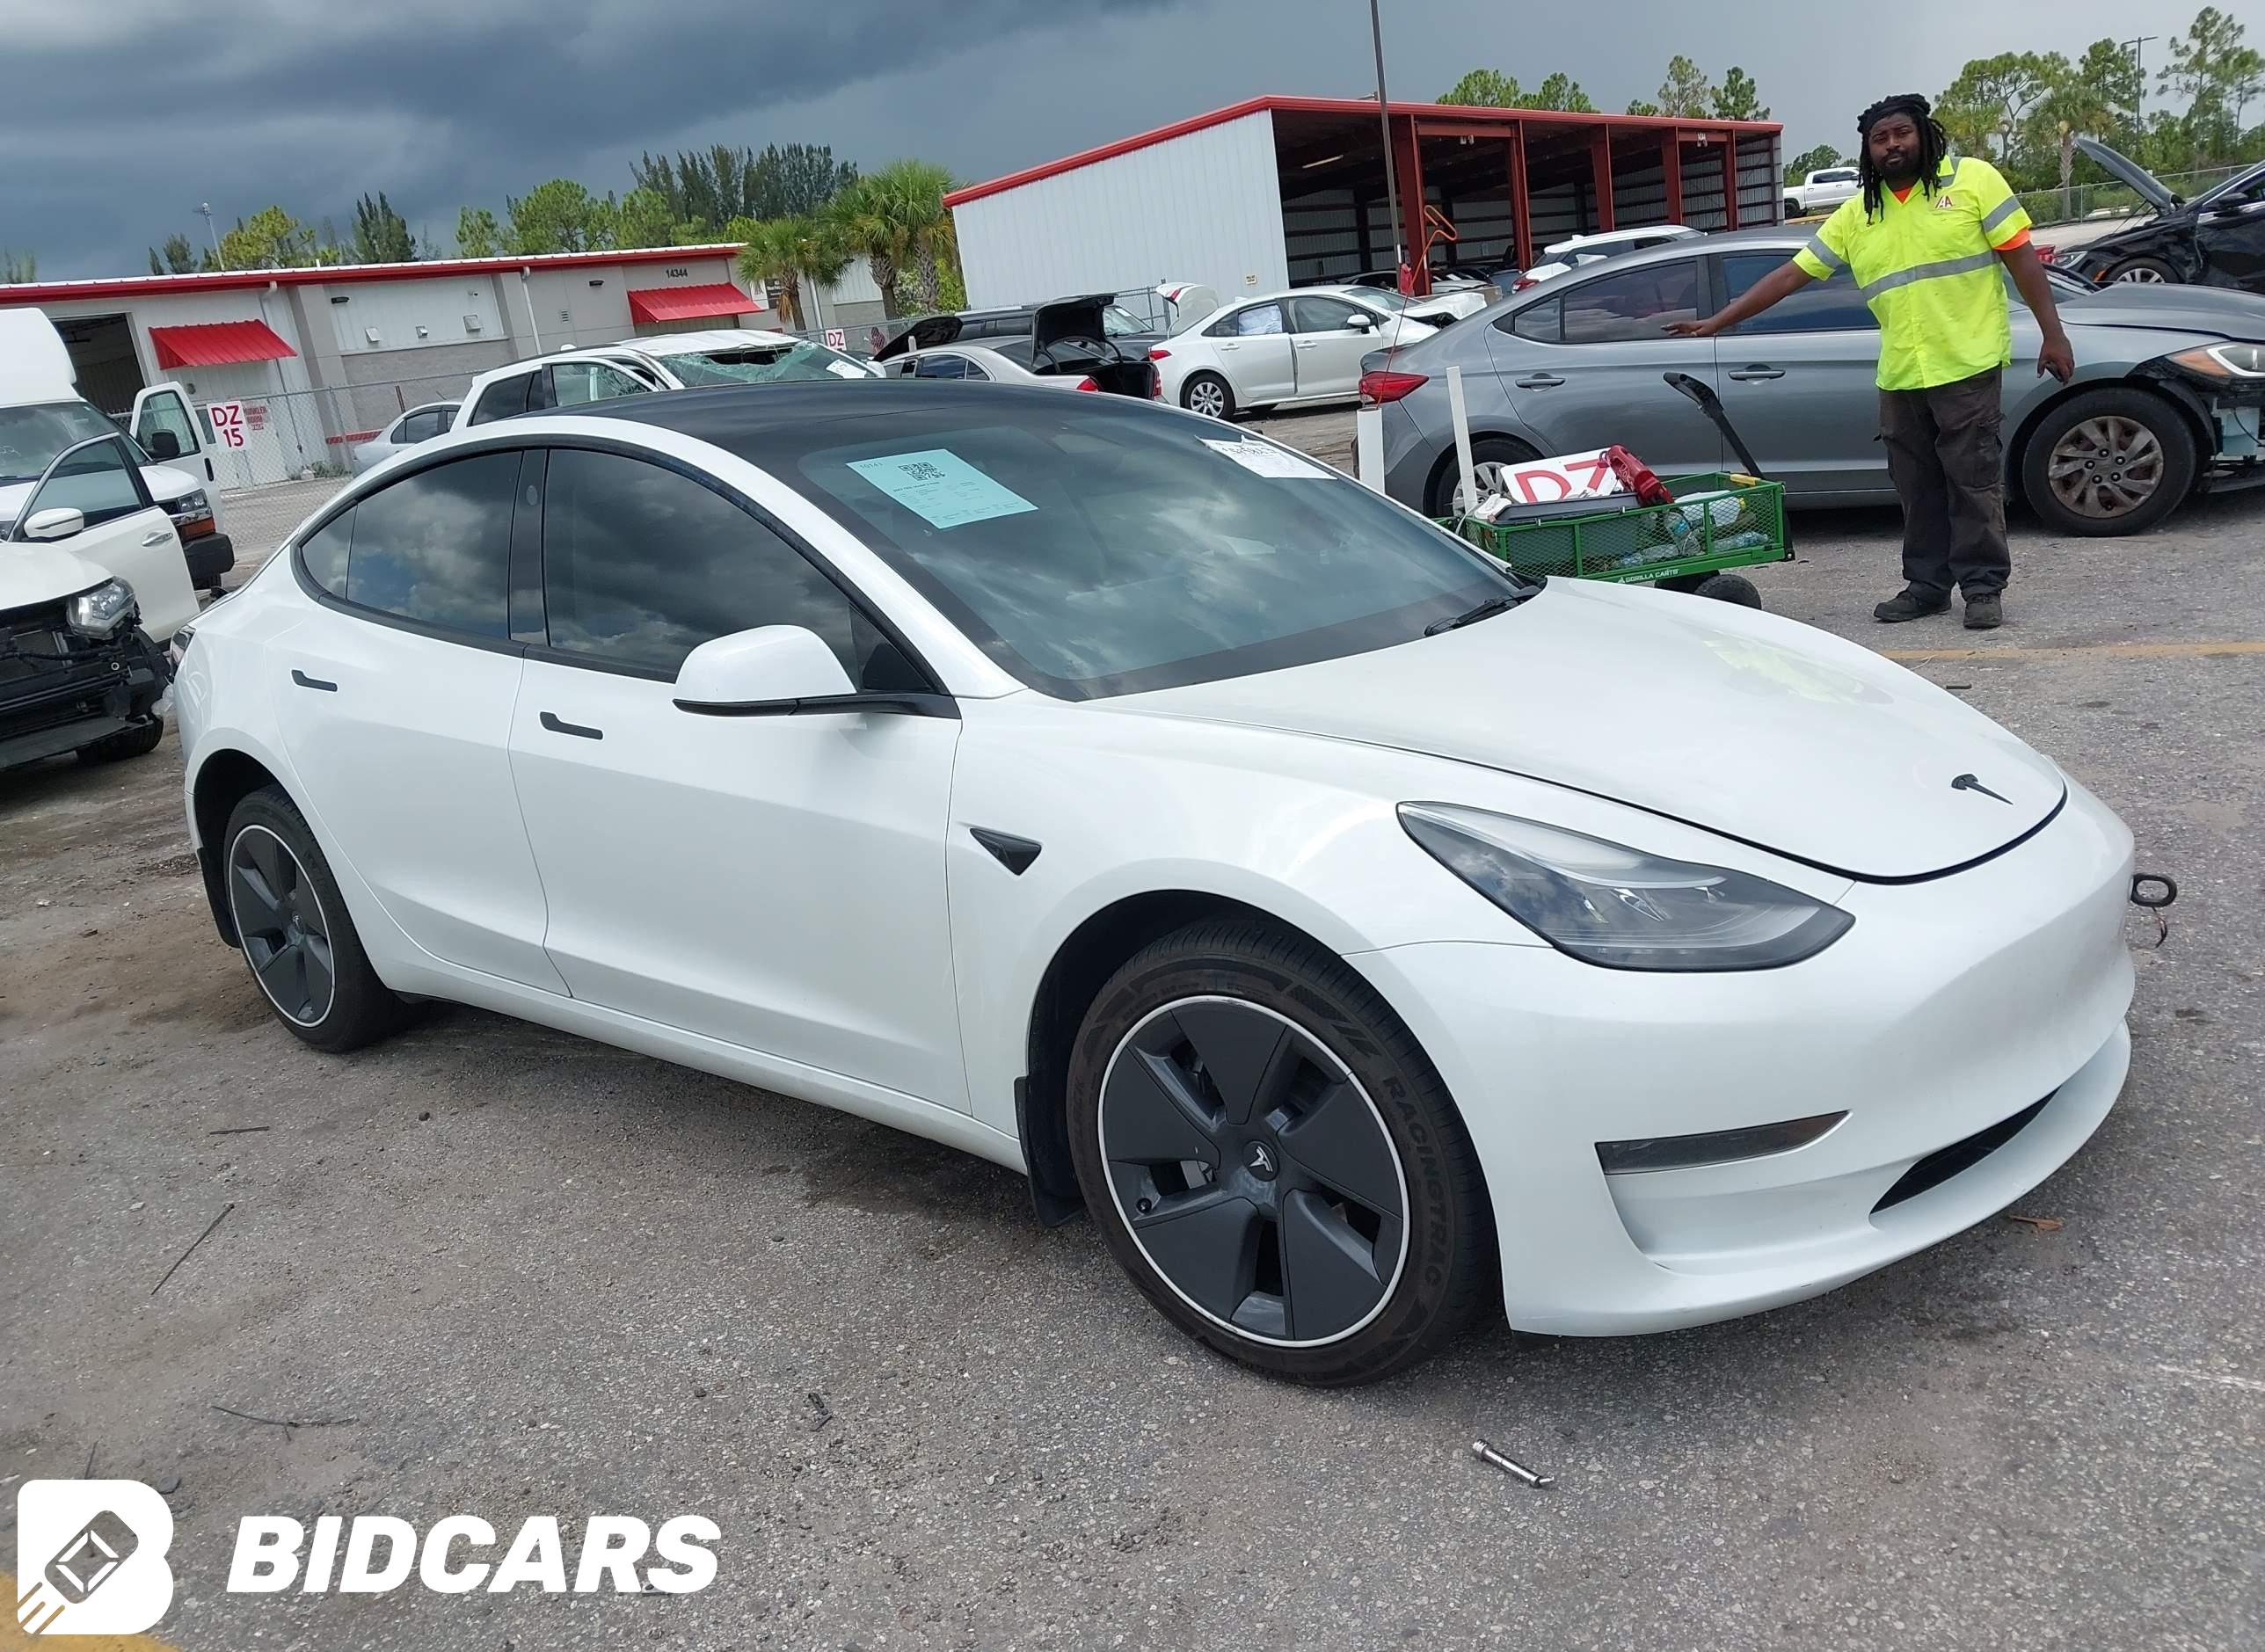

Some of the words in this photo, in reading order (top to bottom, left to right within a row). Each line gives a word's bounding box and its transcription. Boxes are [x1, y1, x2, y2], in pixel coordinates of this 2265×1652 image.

[666, 268, 688, 279] 14344
[827, 331, 844, 347] DZ
[210, 404, 243, 427] DZ
[222, 427, 244, 448] 15
[1625, 572, 1654, 583] GORILLA
[1655, 568, 1679, 578] CARTS
[1382, 1074, 1447, 1287] RACINGTRAC
